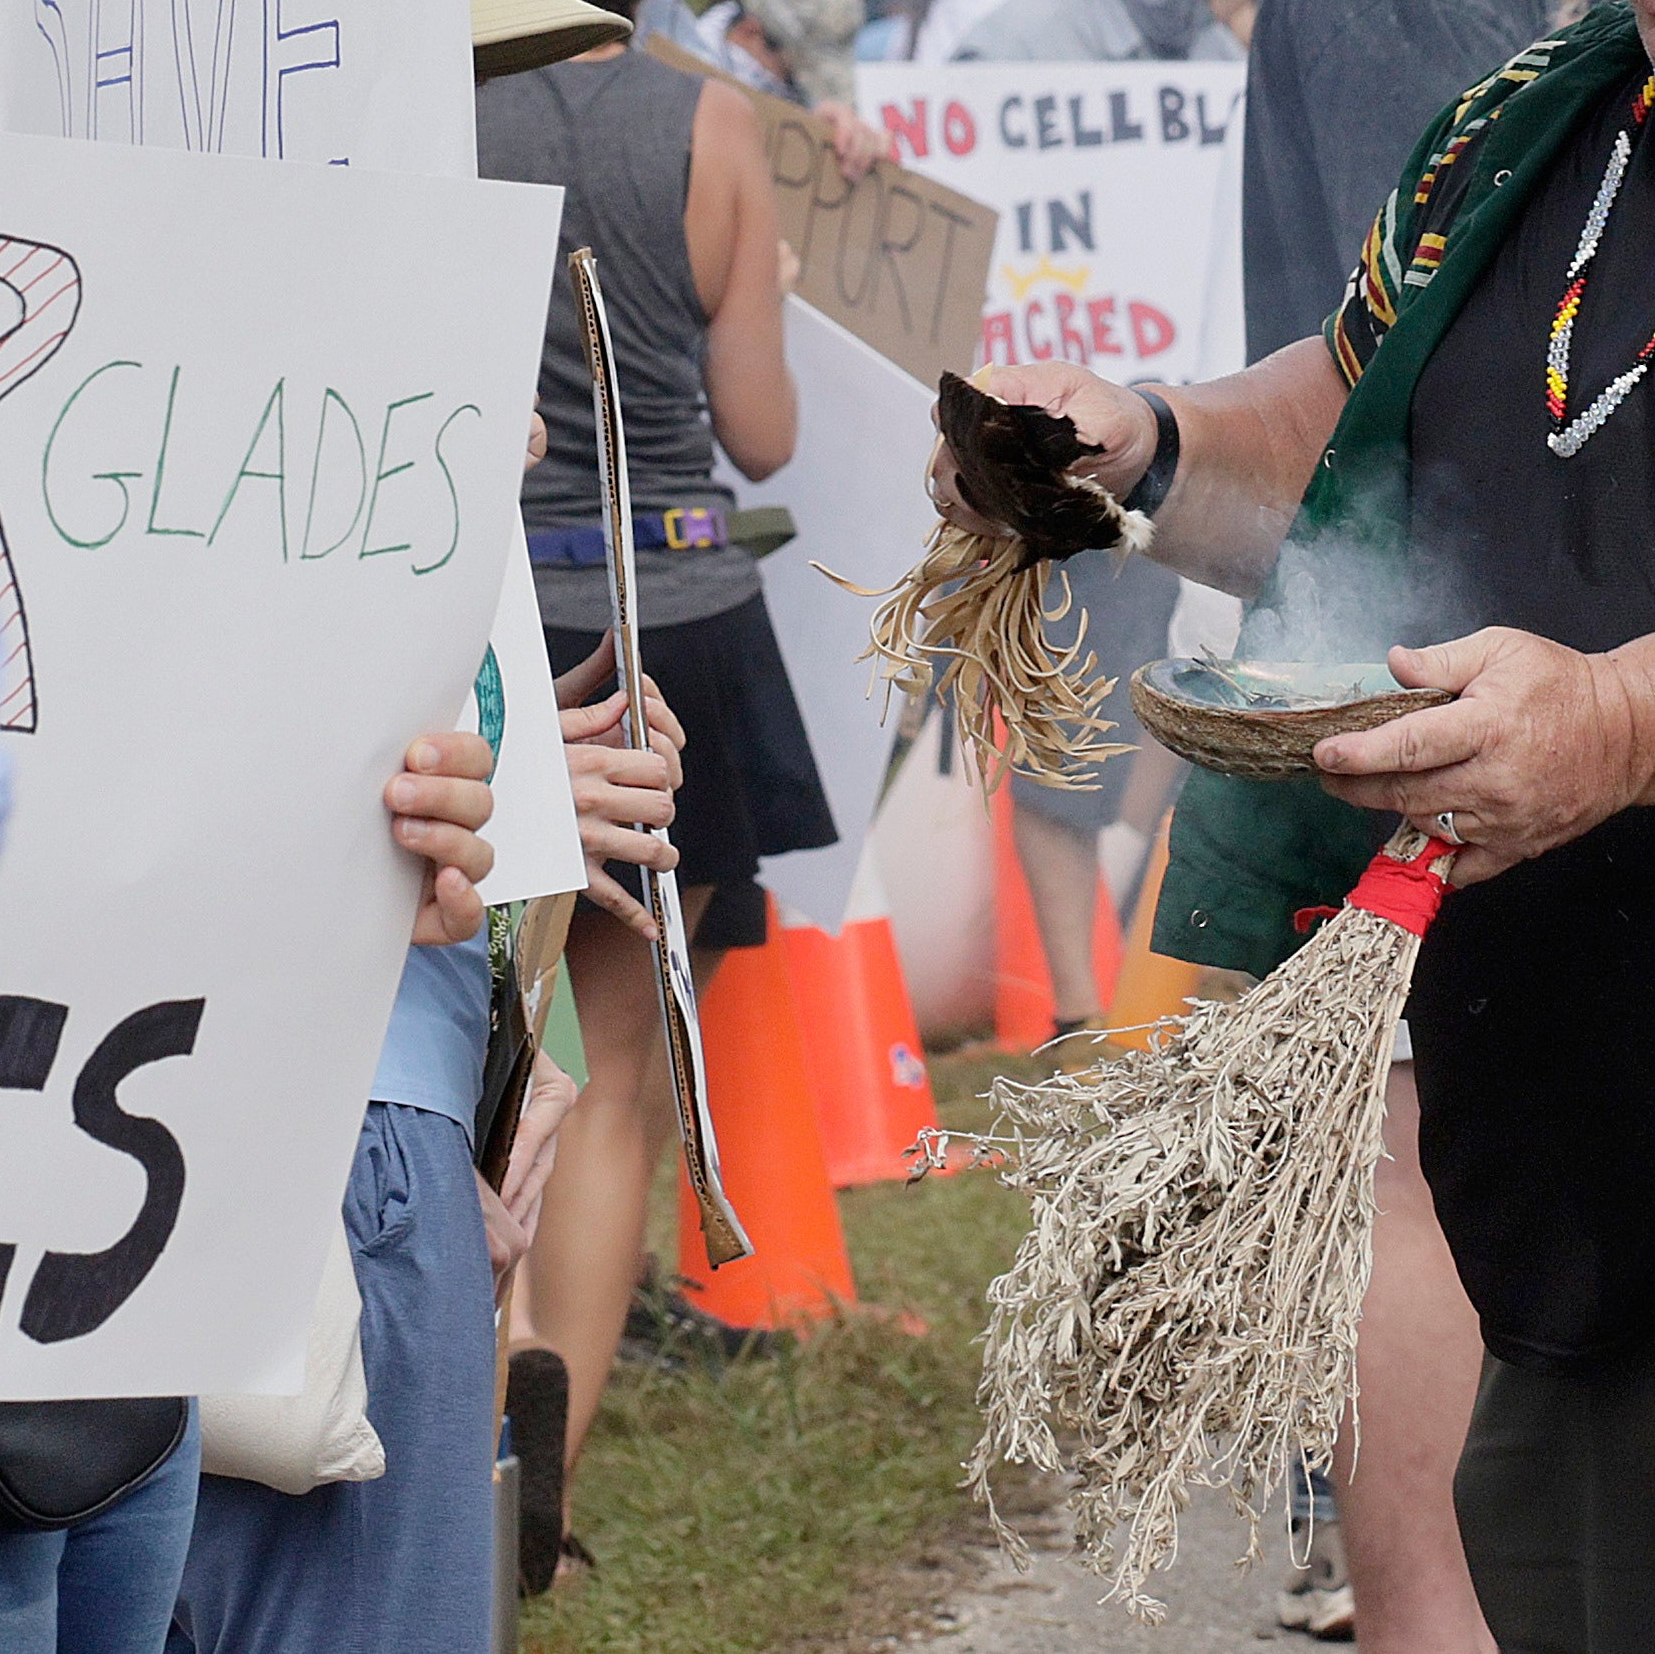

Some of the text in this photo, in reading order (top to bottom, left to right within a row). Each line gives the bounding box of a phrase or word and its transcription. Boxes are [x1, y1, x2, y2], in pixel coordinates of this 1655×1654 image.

[880, 98, 978, 165] NO
[1157, 83, 1244, 146] BL
[1015, 190, 1098, 253] IN
[980, 291, 1177, 367] ACRED
[41, 359, 482, 576] GLADES
